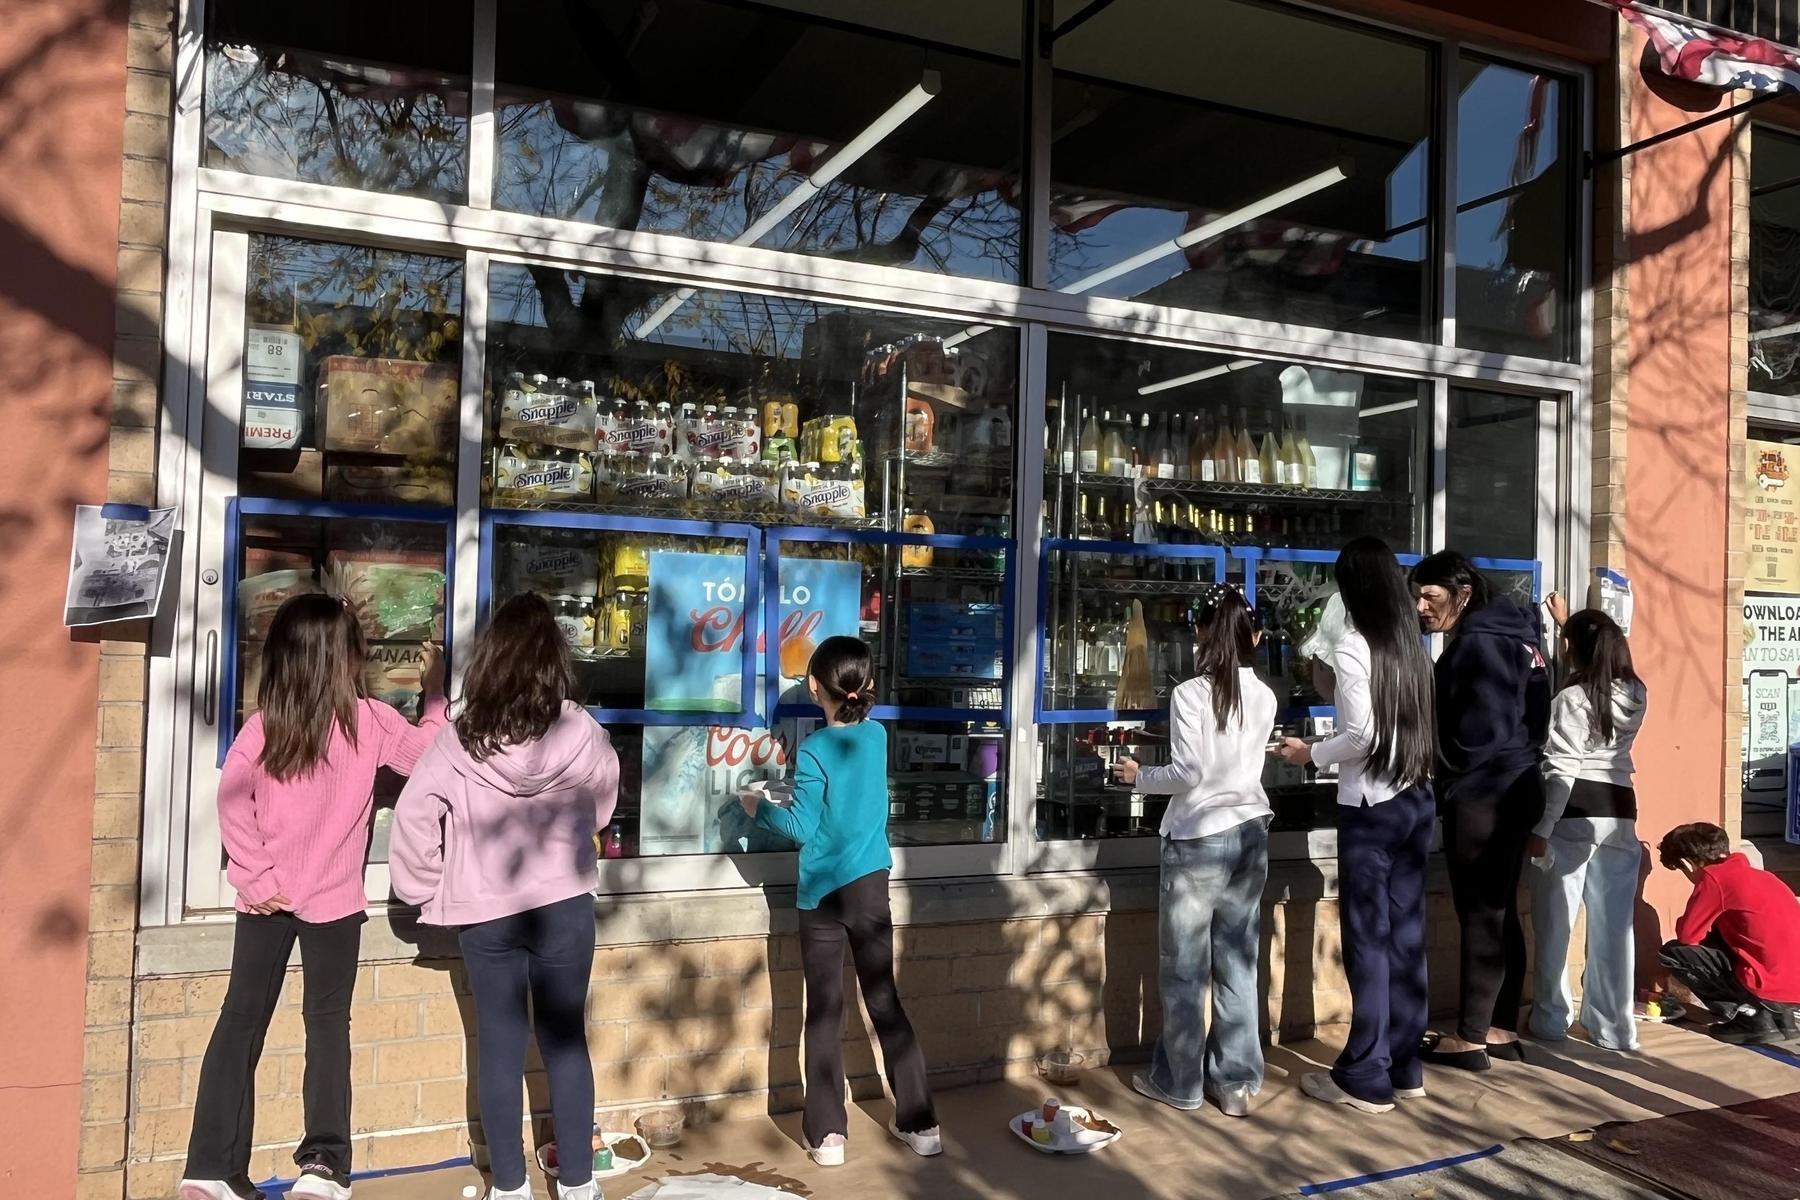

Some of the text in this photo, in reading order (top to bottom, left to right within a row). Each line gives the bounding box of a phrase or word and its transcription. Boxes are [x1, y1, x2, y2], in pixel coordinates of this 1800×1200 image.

[267, 344, 283, 356] 88
[519, 399, 577, 421] Snapple
[606, 424, 656, 443] Snapple
[699, 424, 745, 446] Snapple
[515, 466, 572, 490] Snapple
[801, 486, 849, 508] Snapple
[527, 551, 581, 575] Snapple
[703, 576, 811, 605] TÓLO
[1758, 626, 1786, 641] THE
[1760, 647, 1777, 662] TO
[1755, 688, 1781, 699] SCAN
